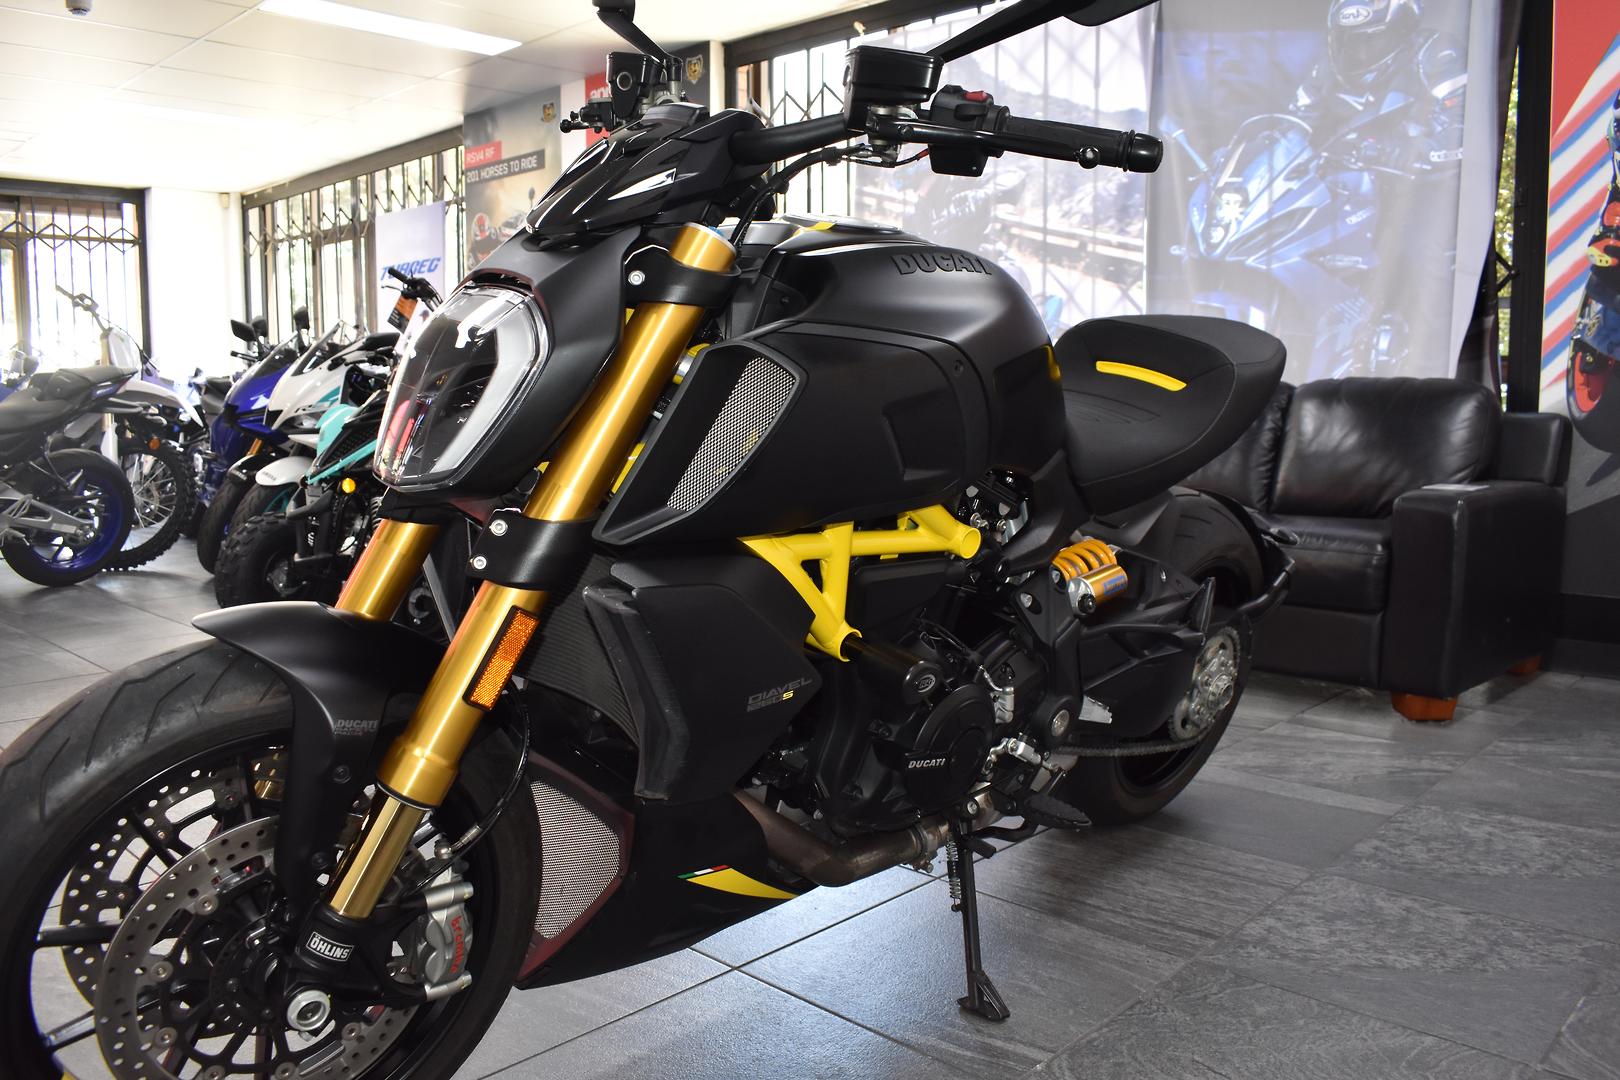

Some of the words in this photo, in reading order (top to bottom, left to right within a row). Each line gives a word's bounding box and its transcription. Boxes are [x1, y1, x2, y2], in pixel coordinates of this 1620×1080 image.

[466, 169, 479, 183] 201
[480, 163, 508, 179] HORSES
[509, 159, 520, 173] TO
[521, 155, 538, 170] RIDE
[890, 252, 992, 276] DUCATI
[748, 677, 812, 705] DIAVEL
[336, 719, 378, 729] DUCATI
[908, 758, 946, 769] DUCATI
[310, 934, 350, 959] ÖHLINS
